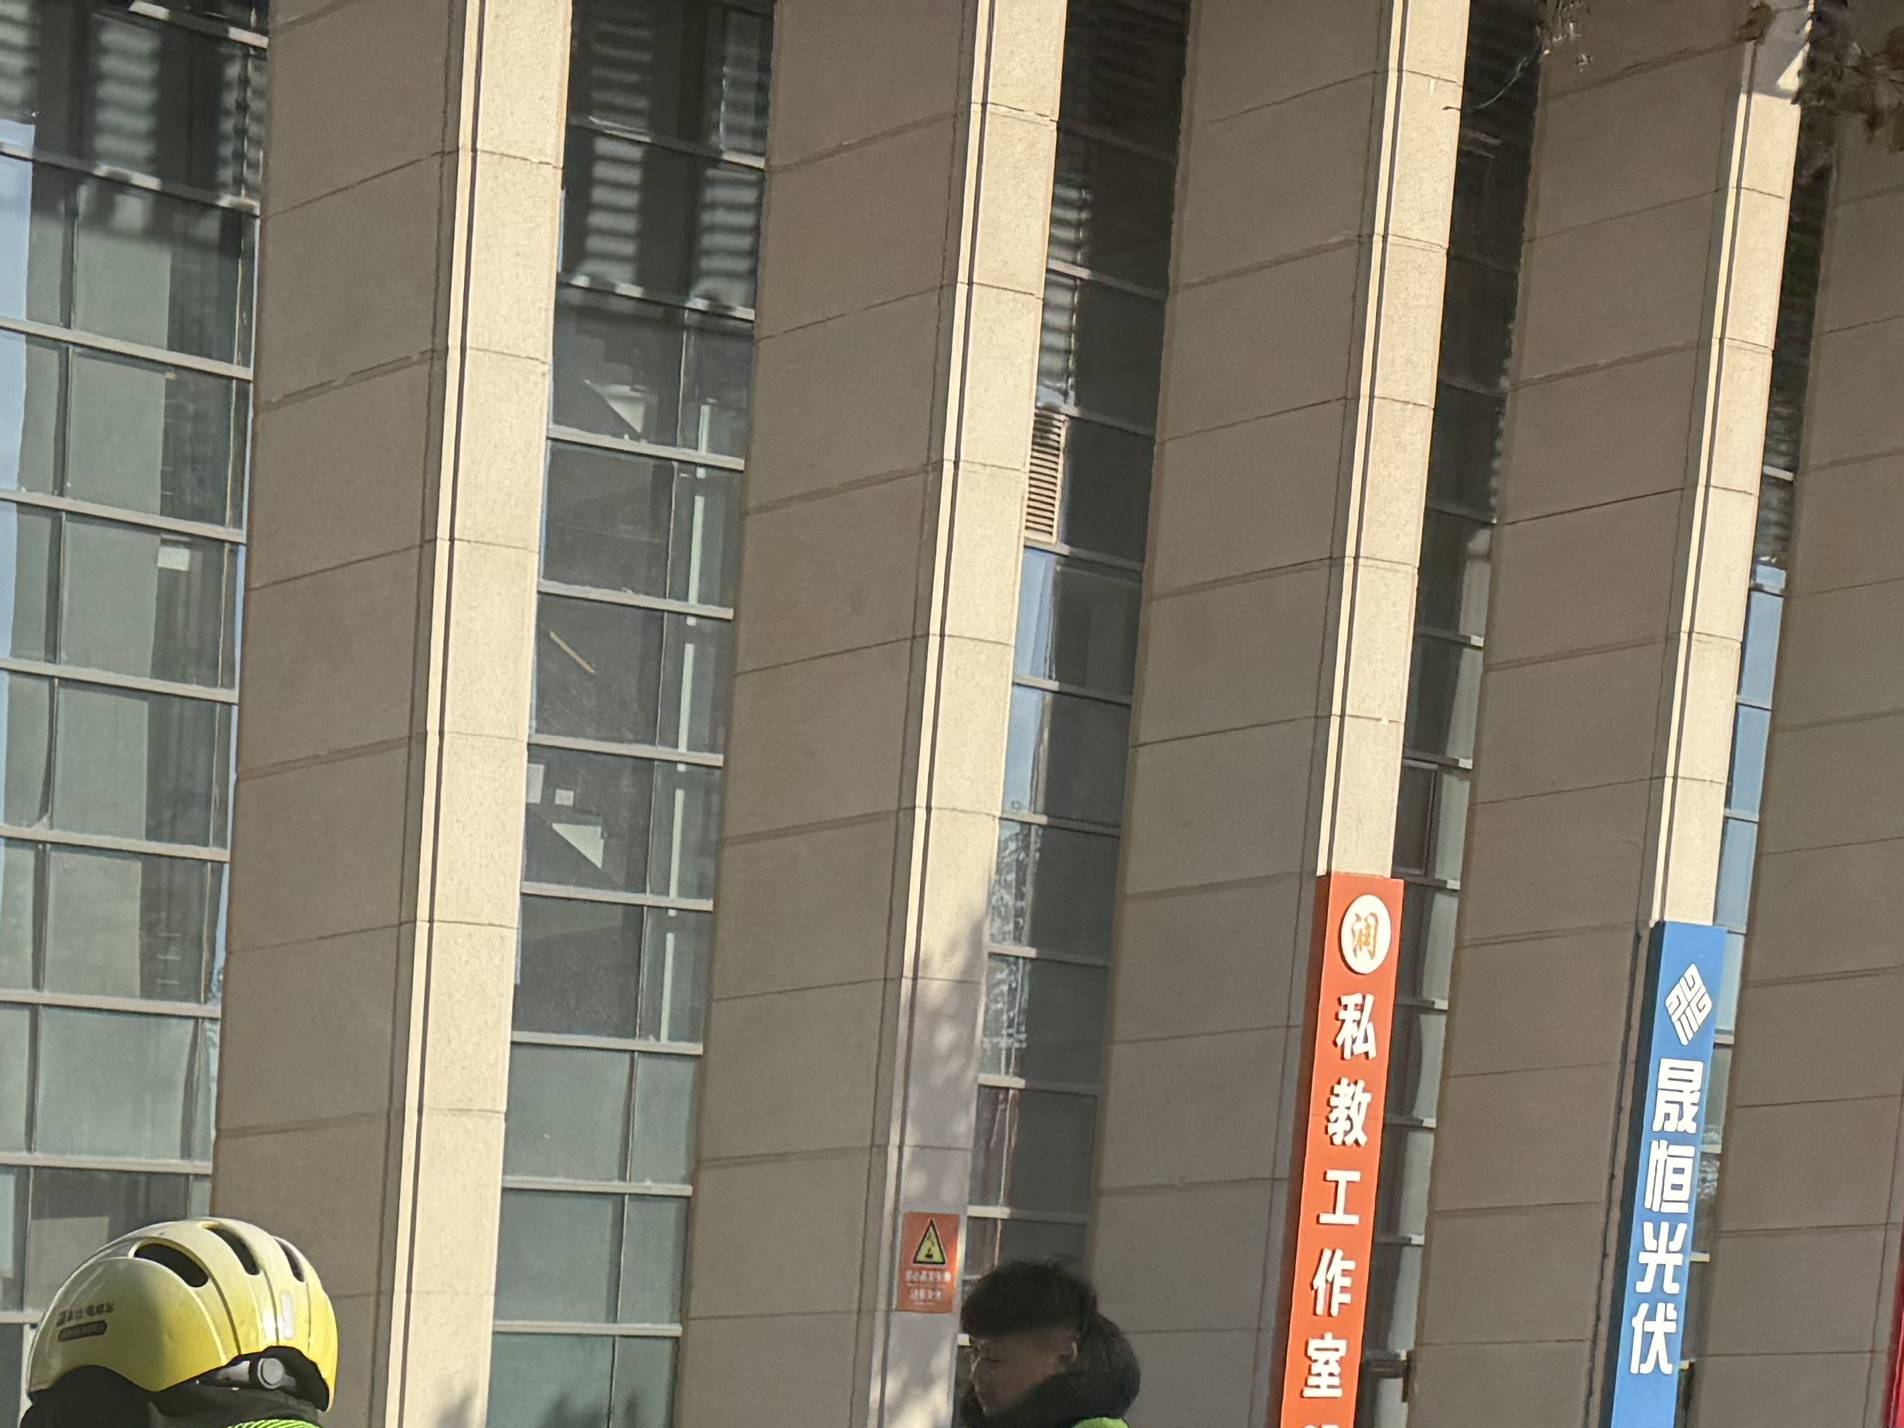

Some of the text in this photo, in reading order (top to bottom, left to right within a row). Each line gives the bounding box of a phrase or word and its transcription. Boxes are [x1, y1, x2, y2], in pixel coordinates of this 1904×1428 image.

[1301, 991, 1378, 1400] 私教工作室
[1630, 1056, 1705, 1376] 晟恒光伏
